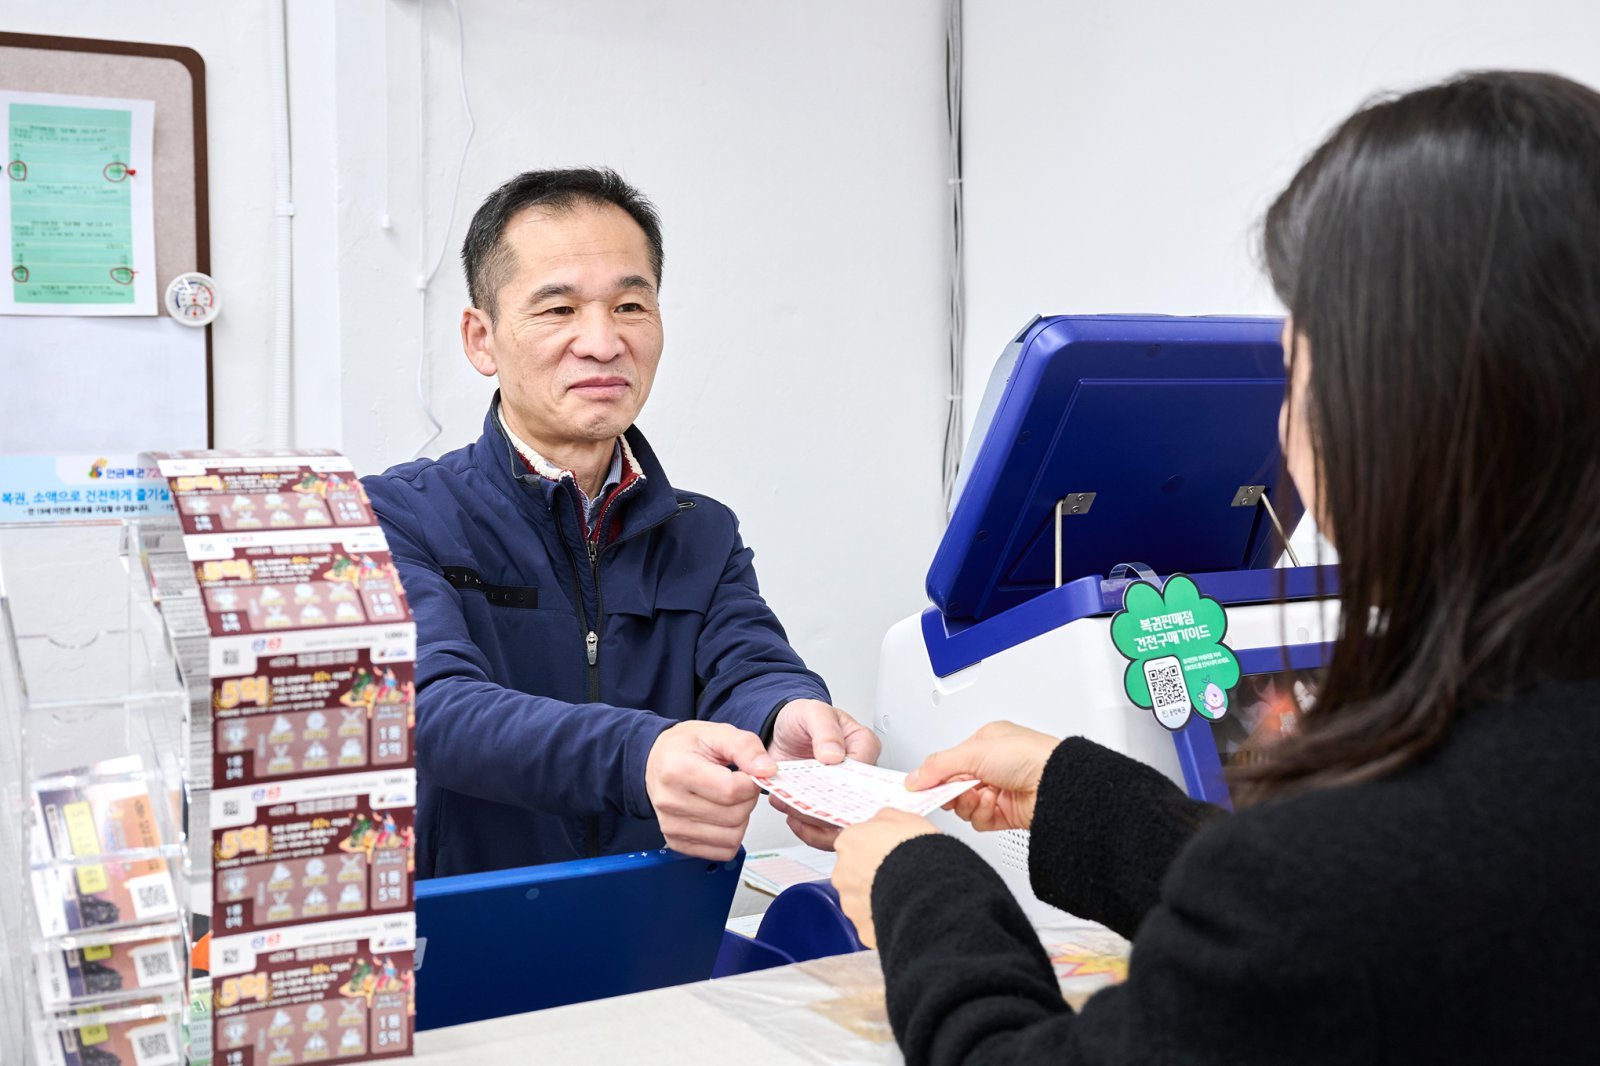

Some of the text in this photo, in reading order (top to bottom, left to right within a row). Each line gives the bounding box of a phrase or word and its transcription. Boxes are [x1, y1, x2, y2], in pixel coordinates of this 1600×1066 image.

[1, 492, 30, 506] 복권,
[33, 489, 82, 503] 소액으로
[85, 488, 132, 502] 건전하게
[1139, 610, 1195, 632] 복권판매점
[1134, 624, 1211, 653] 건전구매가이드
